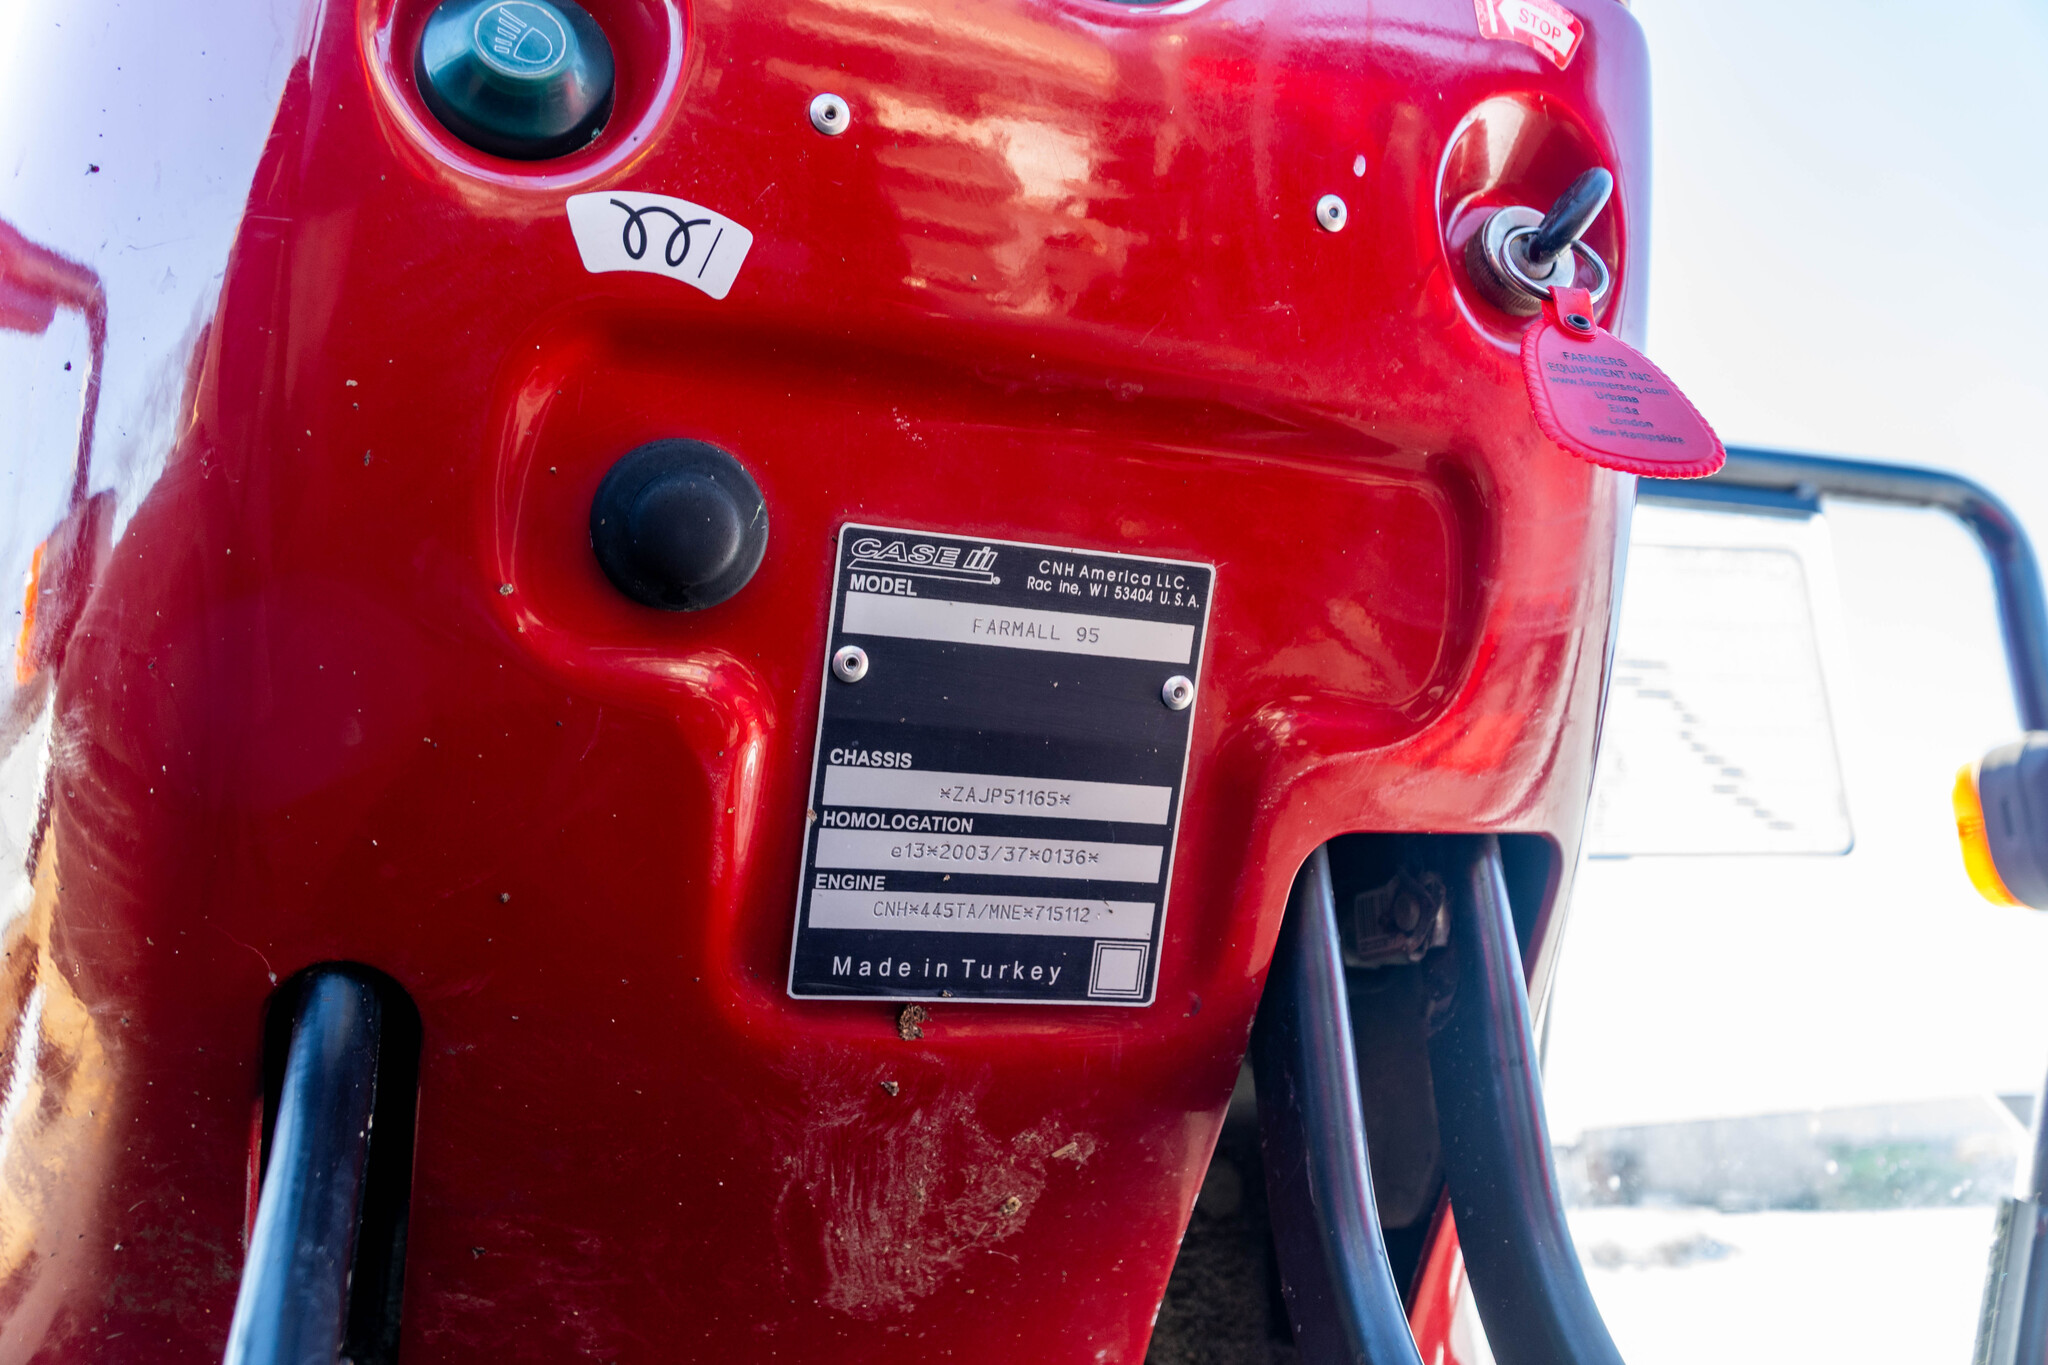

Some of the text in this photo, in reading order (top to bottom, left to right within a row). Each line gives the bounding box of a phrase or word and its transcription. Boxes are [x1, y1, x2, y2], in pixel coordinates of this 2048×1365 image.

[1519, 8, 1562, 39] STOP
[1562, 352, 1628, 367] FARMERS
[1548, 362, 1658, 383] EQUIPMENT INC.
[1549, 376, 1670, 396] www.farmerseq.com
[1595, 391, 1640, 403] Urbana
[1608, 404, 1640, 415] Elida
[1608, 415, 1654, 428] London
[1589, 425, 1686, 444] New Hampshire
[851, 538, 961, 568] CASE
[850, 574, 917, 597] MODEL
[1039, 560, 1190, 590] CNH America LLC.
[1114, 585, 1153, 603] 53404
[973, 618, 1100, 643] FARMALL 95
[829, 748, 913, 769] CHASSIS
[822, 810, 974, 833] HOMOLOGATION
[815, 874, 886, 891] ENGINE
[832, 956, 1062, 984] Made in Turkey
